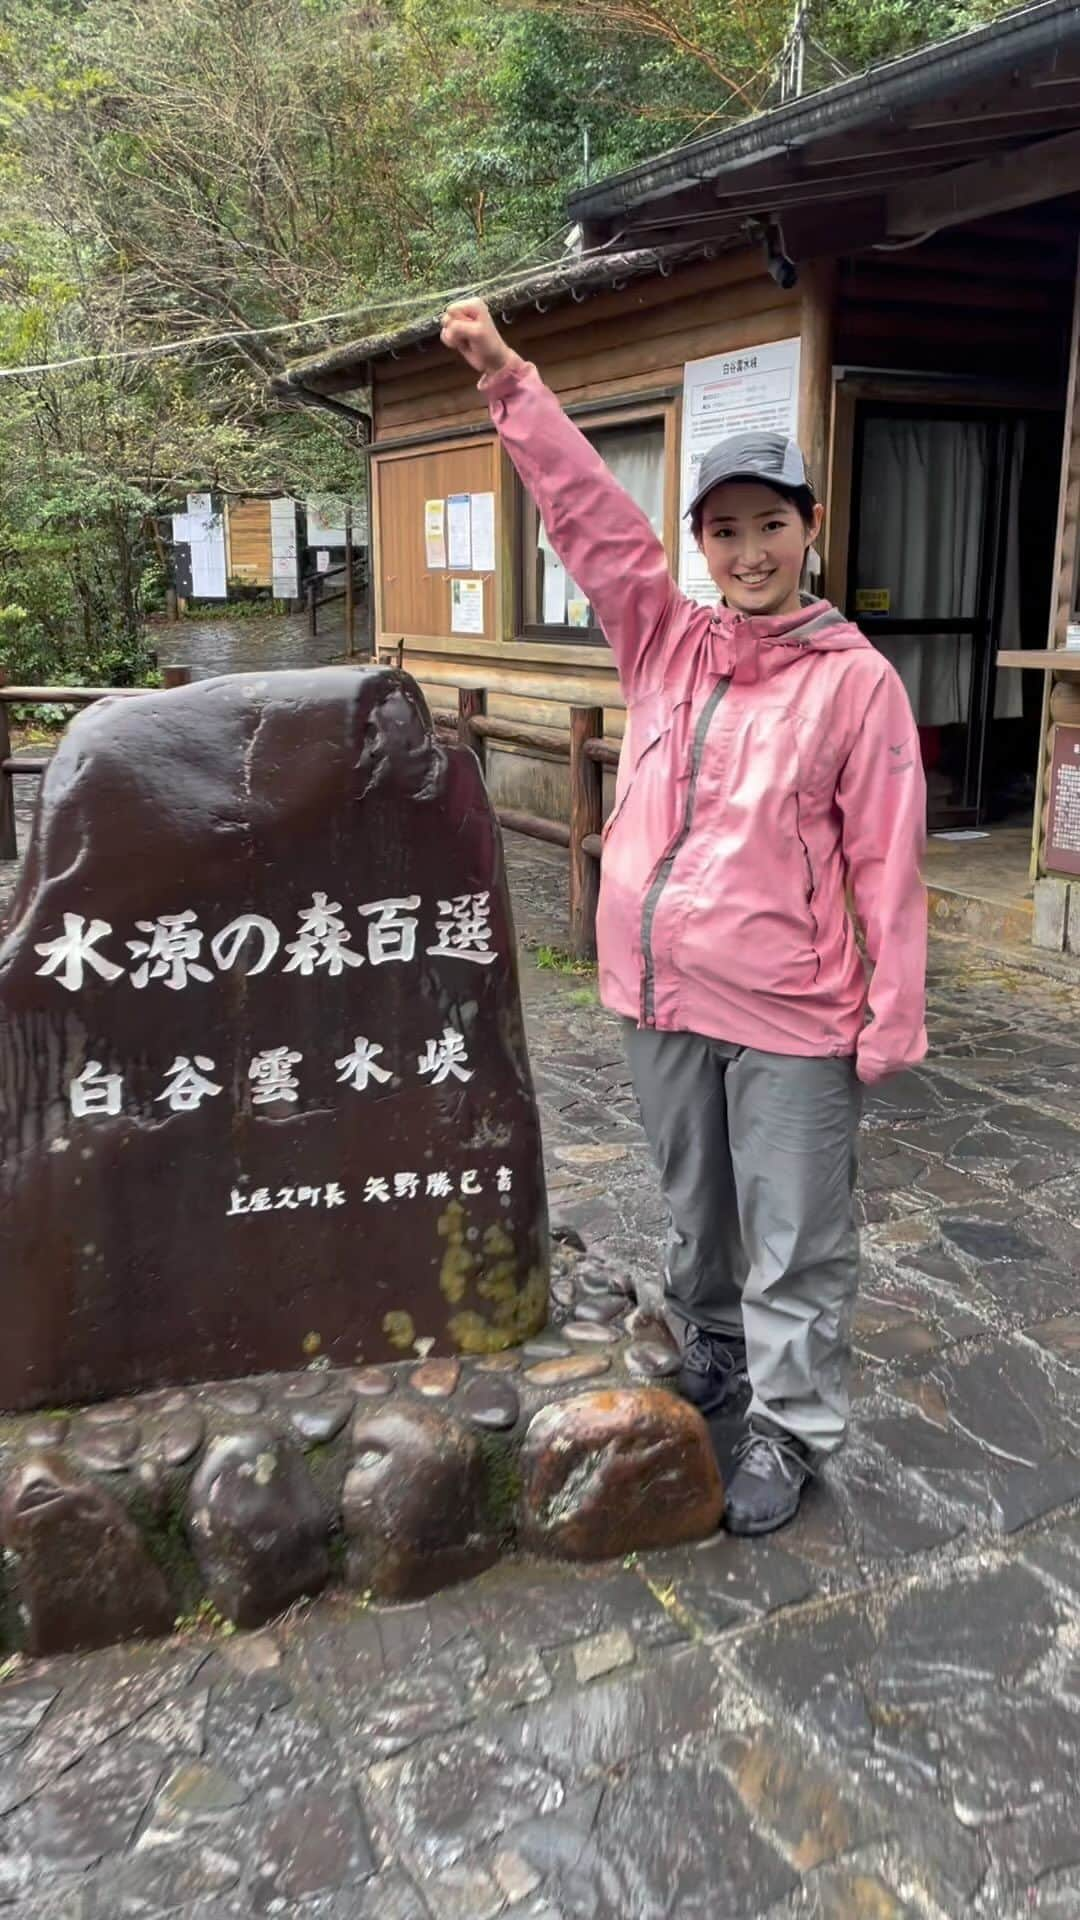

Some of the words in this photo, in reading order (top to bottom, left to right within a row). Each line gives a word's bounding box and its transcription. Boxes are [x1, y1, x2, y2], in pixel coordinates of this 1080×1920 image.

[34, 890, 499, 992] 水源の森百選
[70, 1027, 475, 1118] 白谷雲水峡
[226, 1182, 347, 1216] 上屋久町長
